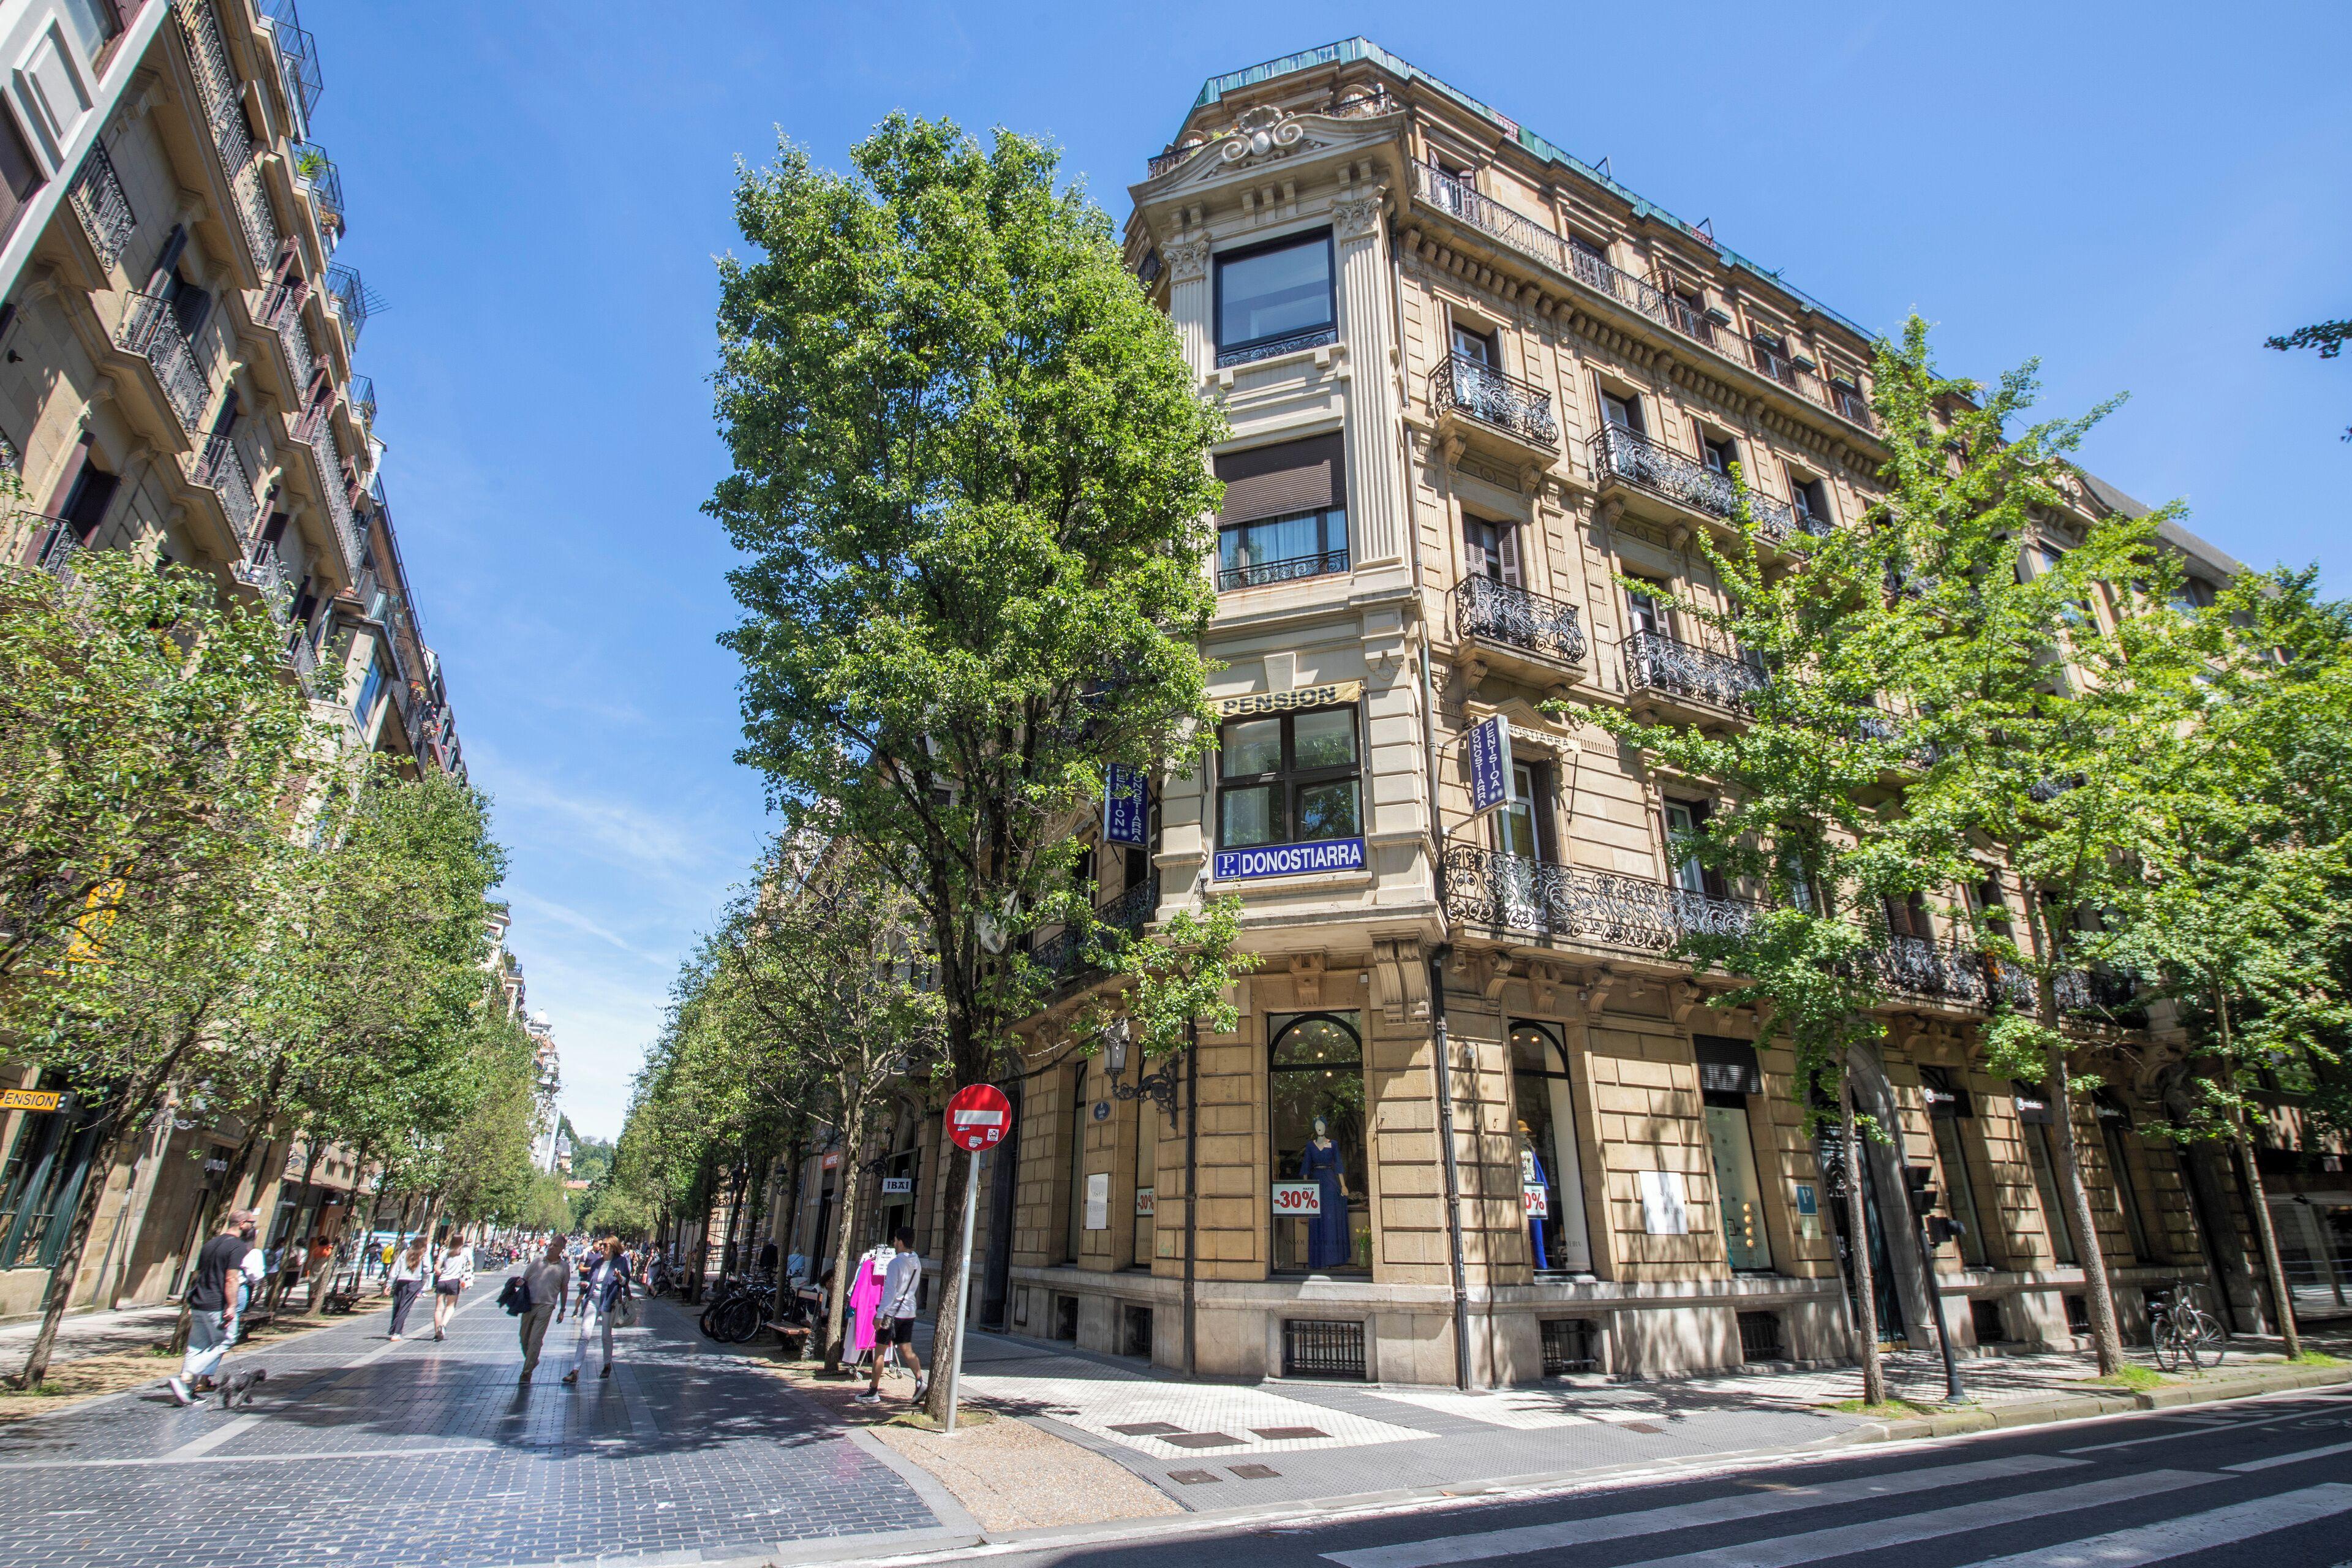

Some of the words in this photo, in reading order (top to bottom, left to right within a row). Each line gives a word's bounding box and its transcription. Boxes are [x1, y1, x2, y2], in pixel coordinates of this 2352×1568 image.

[1224, 686, 1336, 713] PENSION
[1509, 726, 1569, 746] NOSTIARRA
[1485, 720, 1500, 790] PENTSIOA
[1472, 728, 1487, 809] DONOSTIARRA
[1223, 856, 1234, 869] P
[1242, 843, 1362, 874] DONOSTIARRA
[1274, 1191, 1319, 1209] -30%
[1524, 1193, 1544, 1210] 0%
[1802, 1189, 1810, 1204] P
